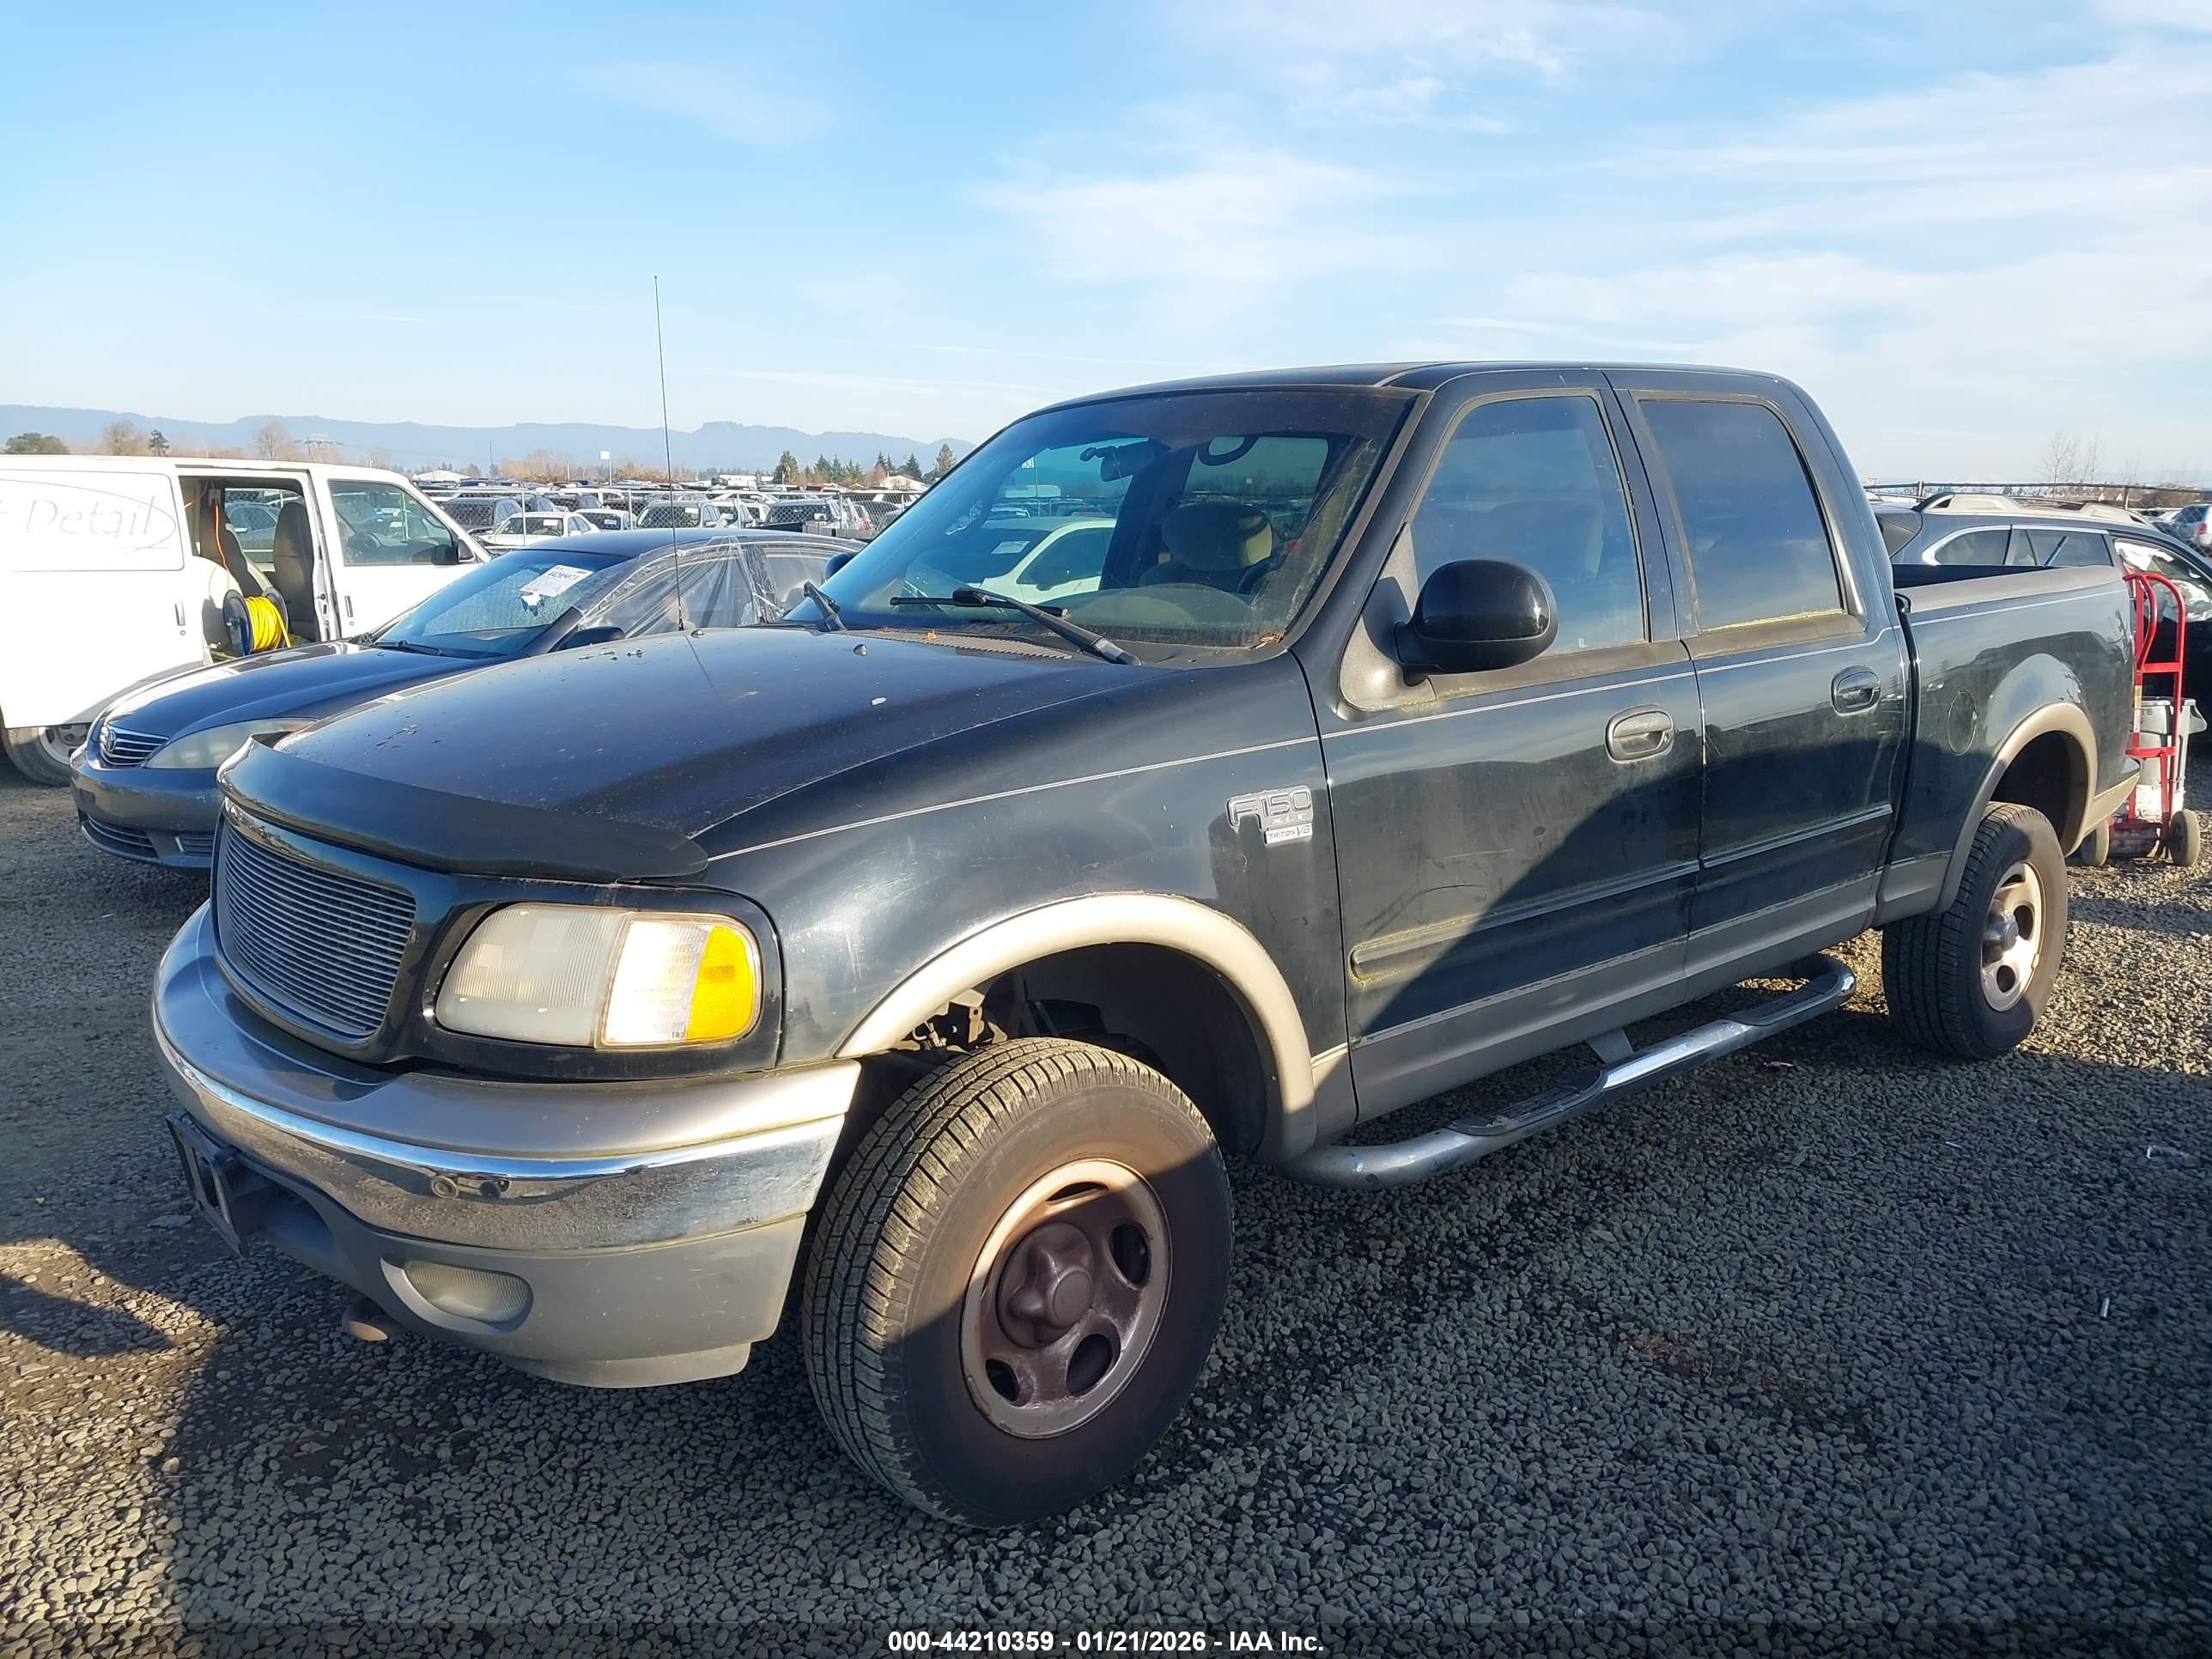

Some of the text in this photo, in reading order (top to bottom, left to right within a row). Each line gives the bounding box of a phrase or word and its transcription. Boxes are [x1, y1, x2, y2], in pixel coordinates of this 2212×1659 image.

[26, 495, 155, 538] Detail
[1272, 812, 1306, 824] XLT
[1268, 825, 1310, 840] TRITON V8
